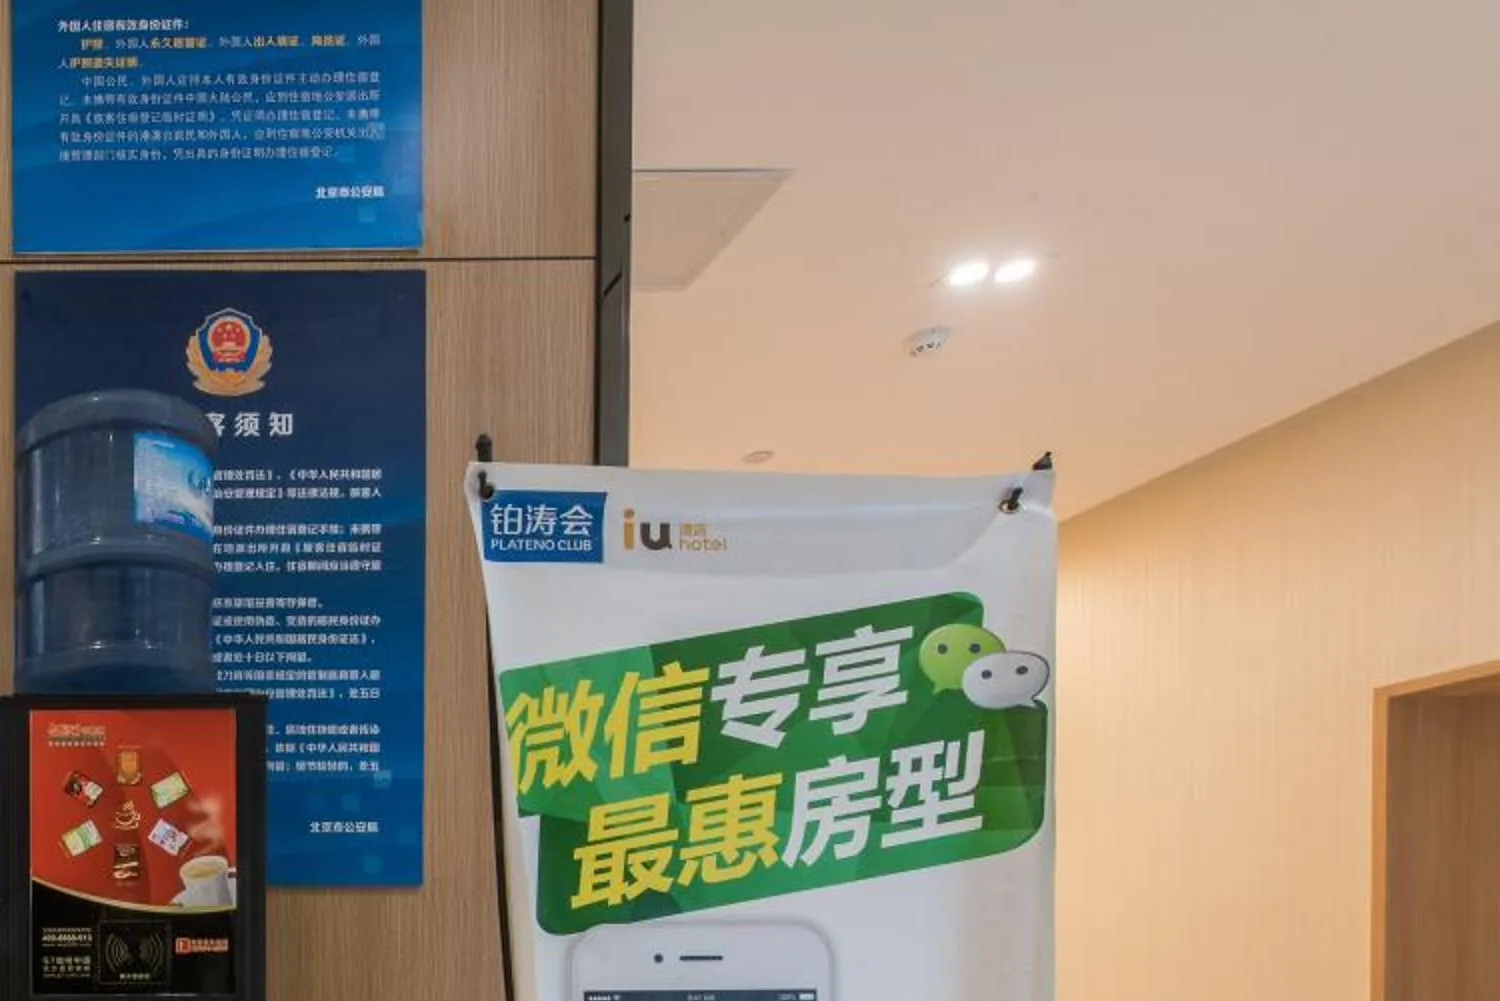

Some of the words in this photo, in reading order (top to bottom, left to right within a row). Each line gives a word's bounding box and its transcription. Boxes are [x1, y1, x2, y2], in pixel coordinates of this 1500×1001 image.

[490, 503, 594, 536] 铂涛会
[490, 539, 555, 551] PLATENO
[557, 540, 592, 552] CLUB
[679, 537, 728, 551] hotel
[504, 623, 915, 796] 微信专享
[570, 729, 986, 910] 最惠房型
